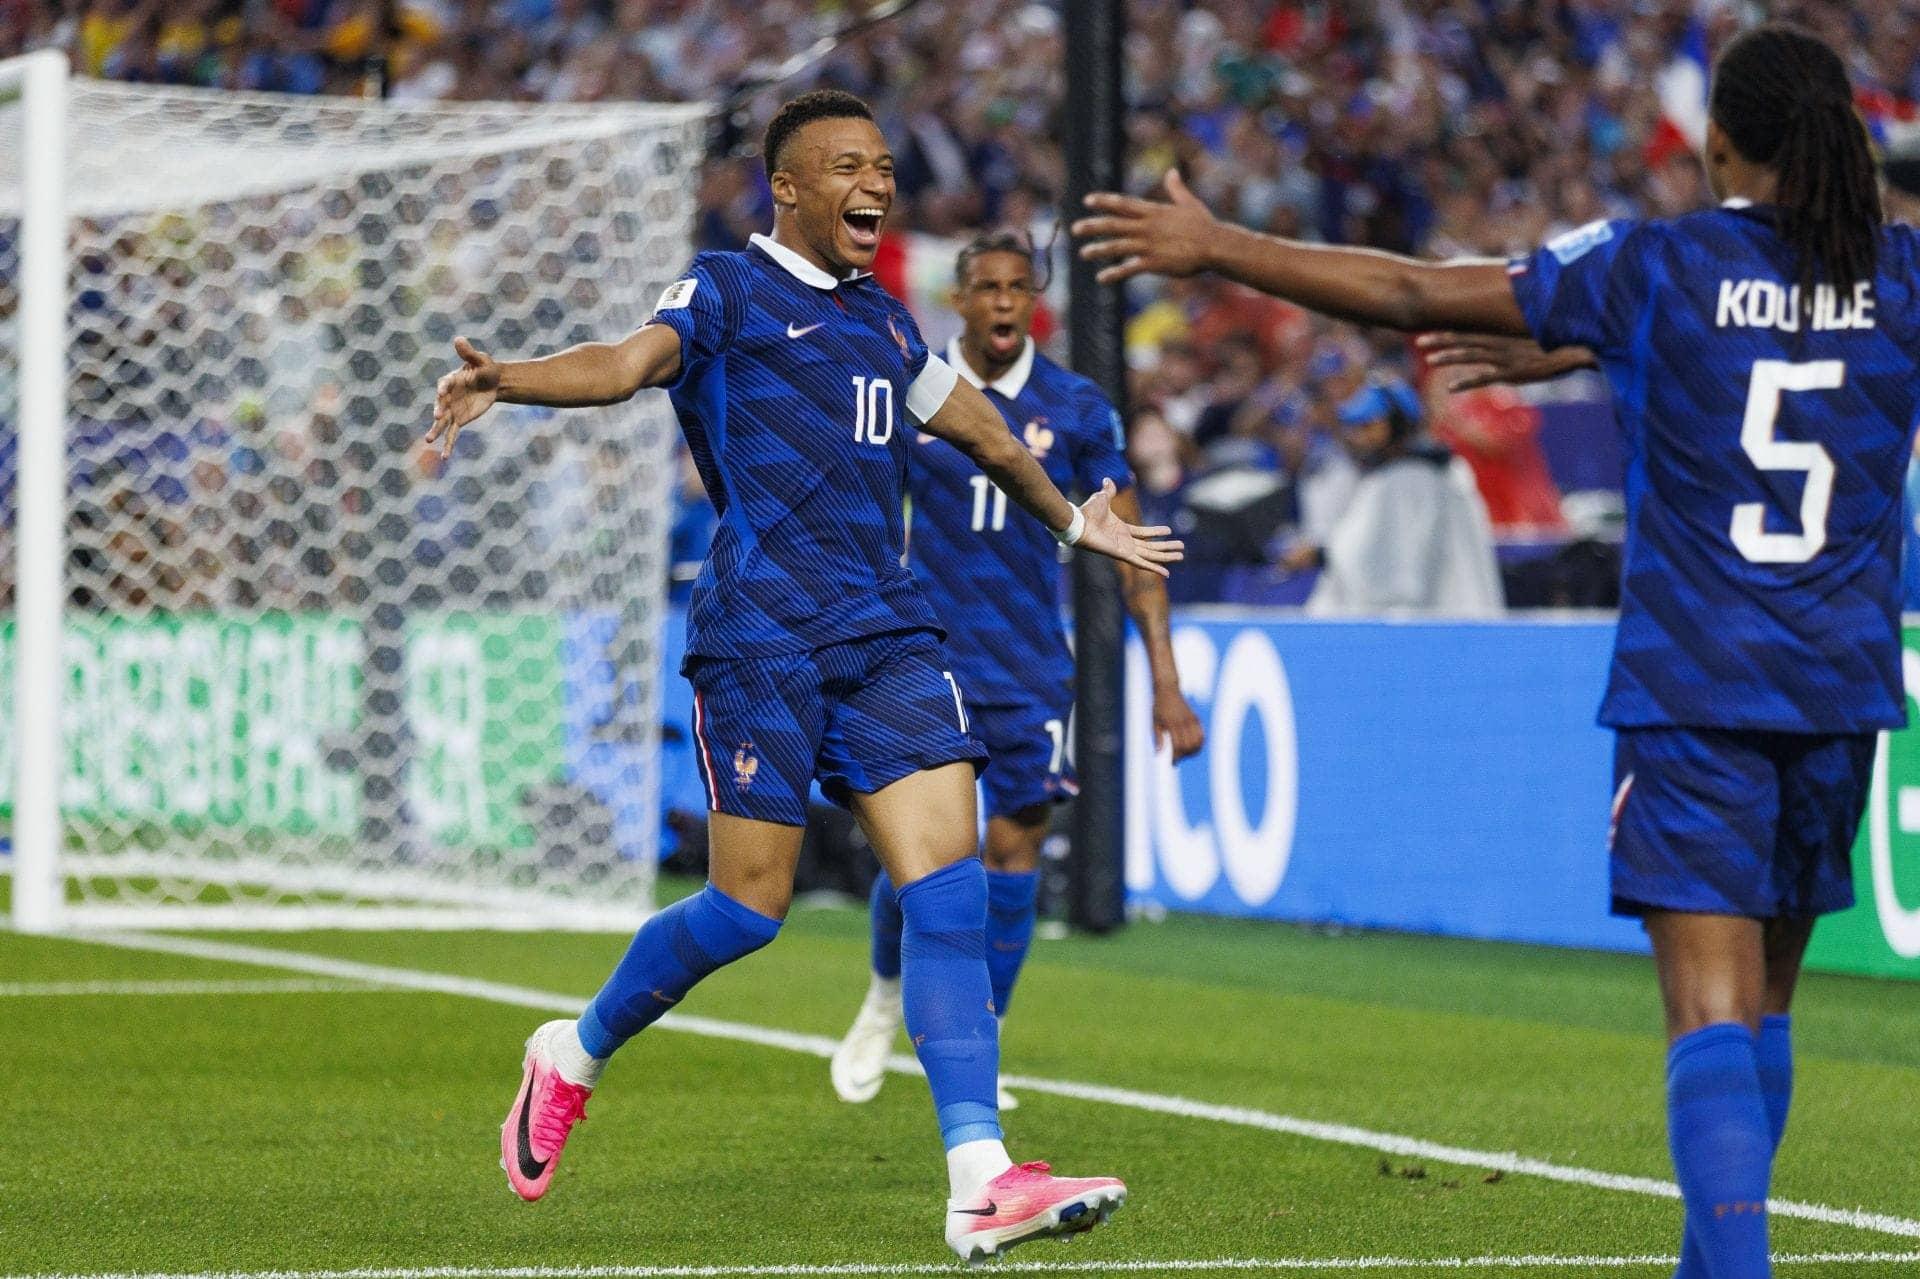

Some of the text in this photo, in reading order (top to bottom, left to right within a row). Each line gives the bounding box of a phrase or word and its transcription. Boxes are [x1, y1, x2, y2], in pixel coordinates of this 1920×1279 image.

[852, 376, 893, 445] 10
[1729, 360, 1844, 563] 5
[969, 475, 1008, 532] 11
[943, 671, 968, 733] 1
